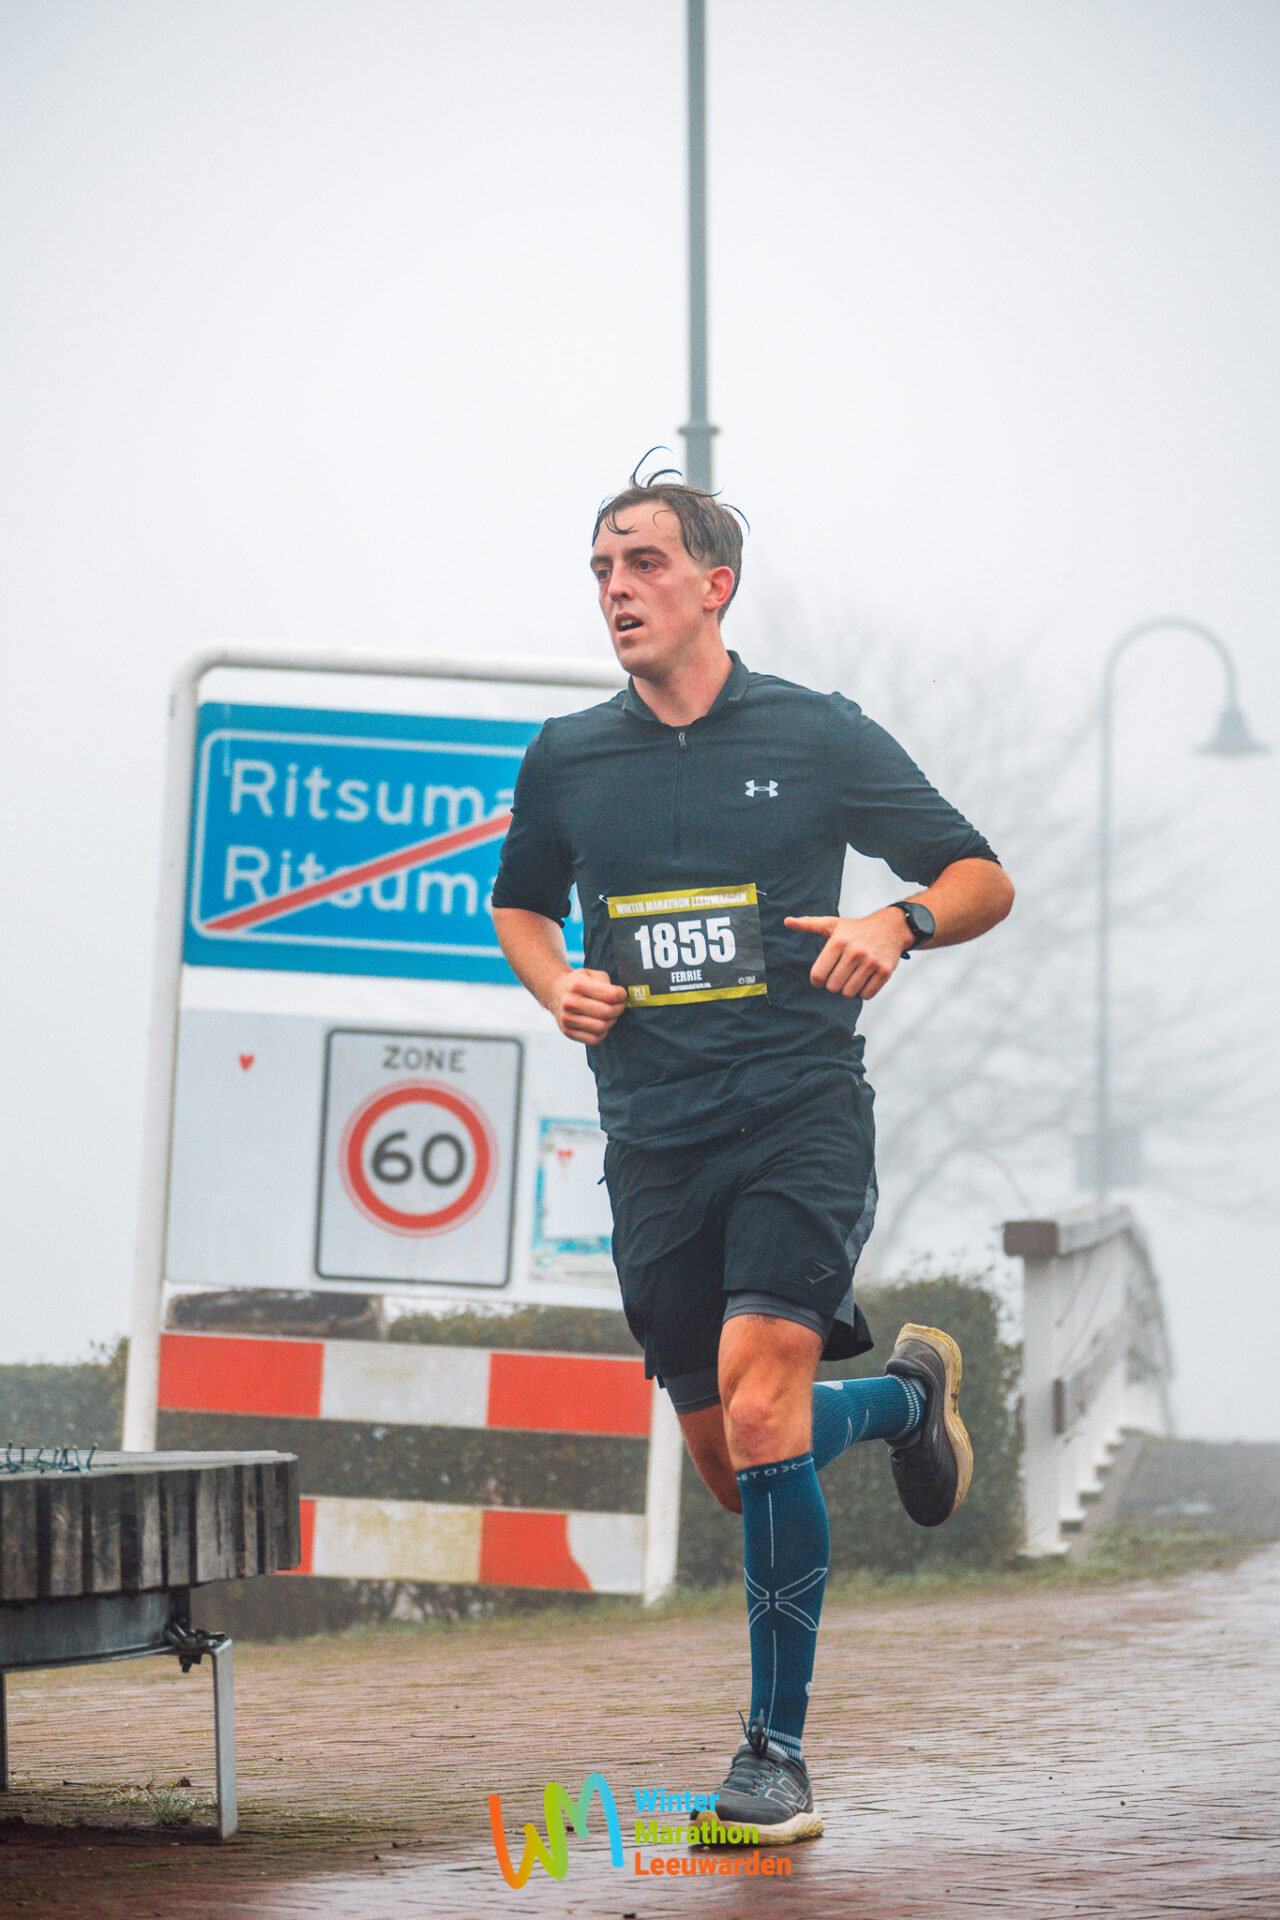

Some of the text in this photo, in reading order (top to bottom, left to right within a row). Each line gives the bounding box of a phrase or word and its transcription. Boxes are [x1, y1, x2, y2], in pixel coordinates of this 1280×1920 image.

[615, 901, 645, 914] WINTER
[645, 897, 690, 912] MARATHON
[634, 916, 736, 970] 1855
[670, 969, 703, 983] FERRIE
[382, 1045, 467, 1073] ZONE
[371, 1129, 466, 1187] 60
